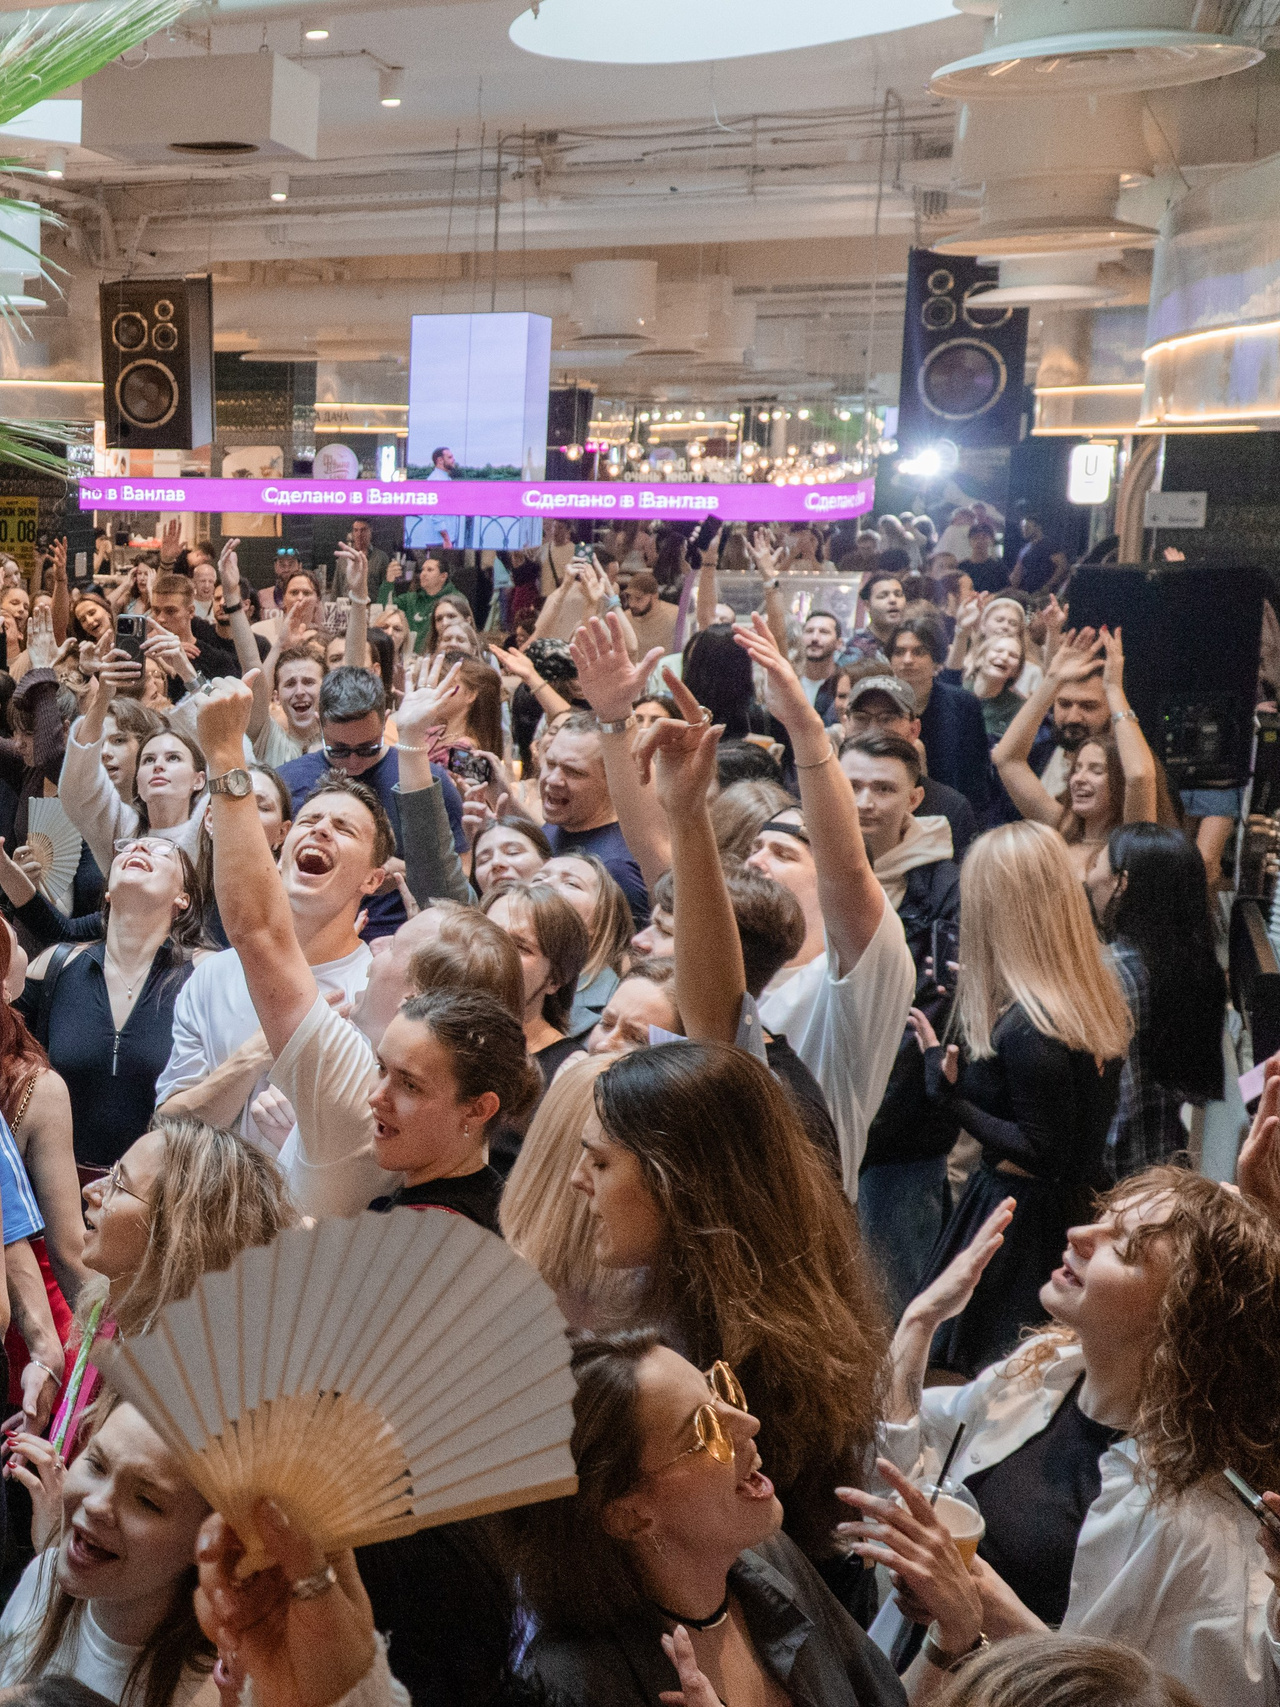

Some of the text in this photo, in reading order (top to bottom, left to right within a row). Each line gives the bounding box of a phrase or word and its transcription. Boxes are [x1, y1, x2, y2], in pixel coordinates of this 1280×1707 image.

[105, 489, 118, 501] в
[120, 485, 186, 502] Ванлав
[261, 487, 439, 506] Сделано в Ванлав
[522, 489, 720, 510] Сделано в Ванлав
